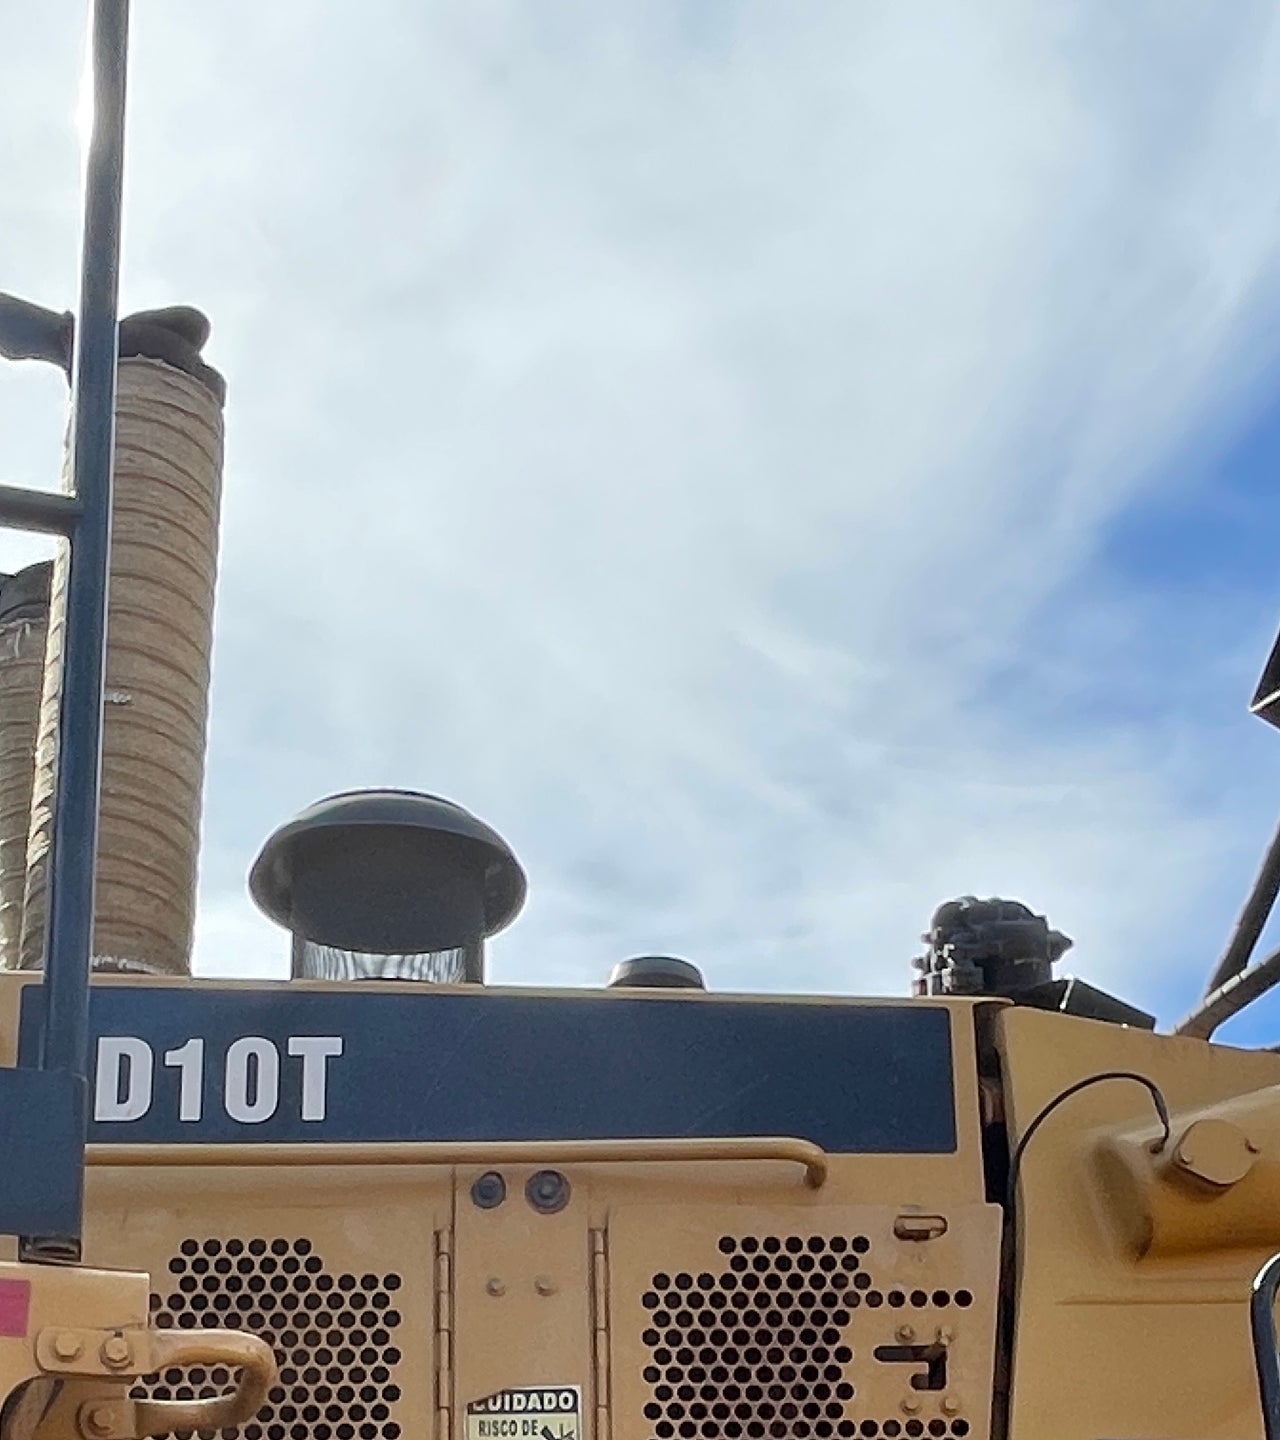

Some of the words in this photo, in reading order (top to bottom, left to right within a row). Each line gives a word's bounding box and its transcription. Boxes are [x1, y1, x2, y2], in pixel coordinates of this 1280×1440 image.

[93, 1036, 344, 1123] D10T
[478, 1419, 518, 1437] RISCO
[522, 1419, 539, 1436] DE
